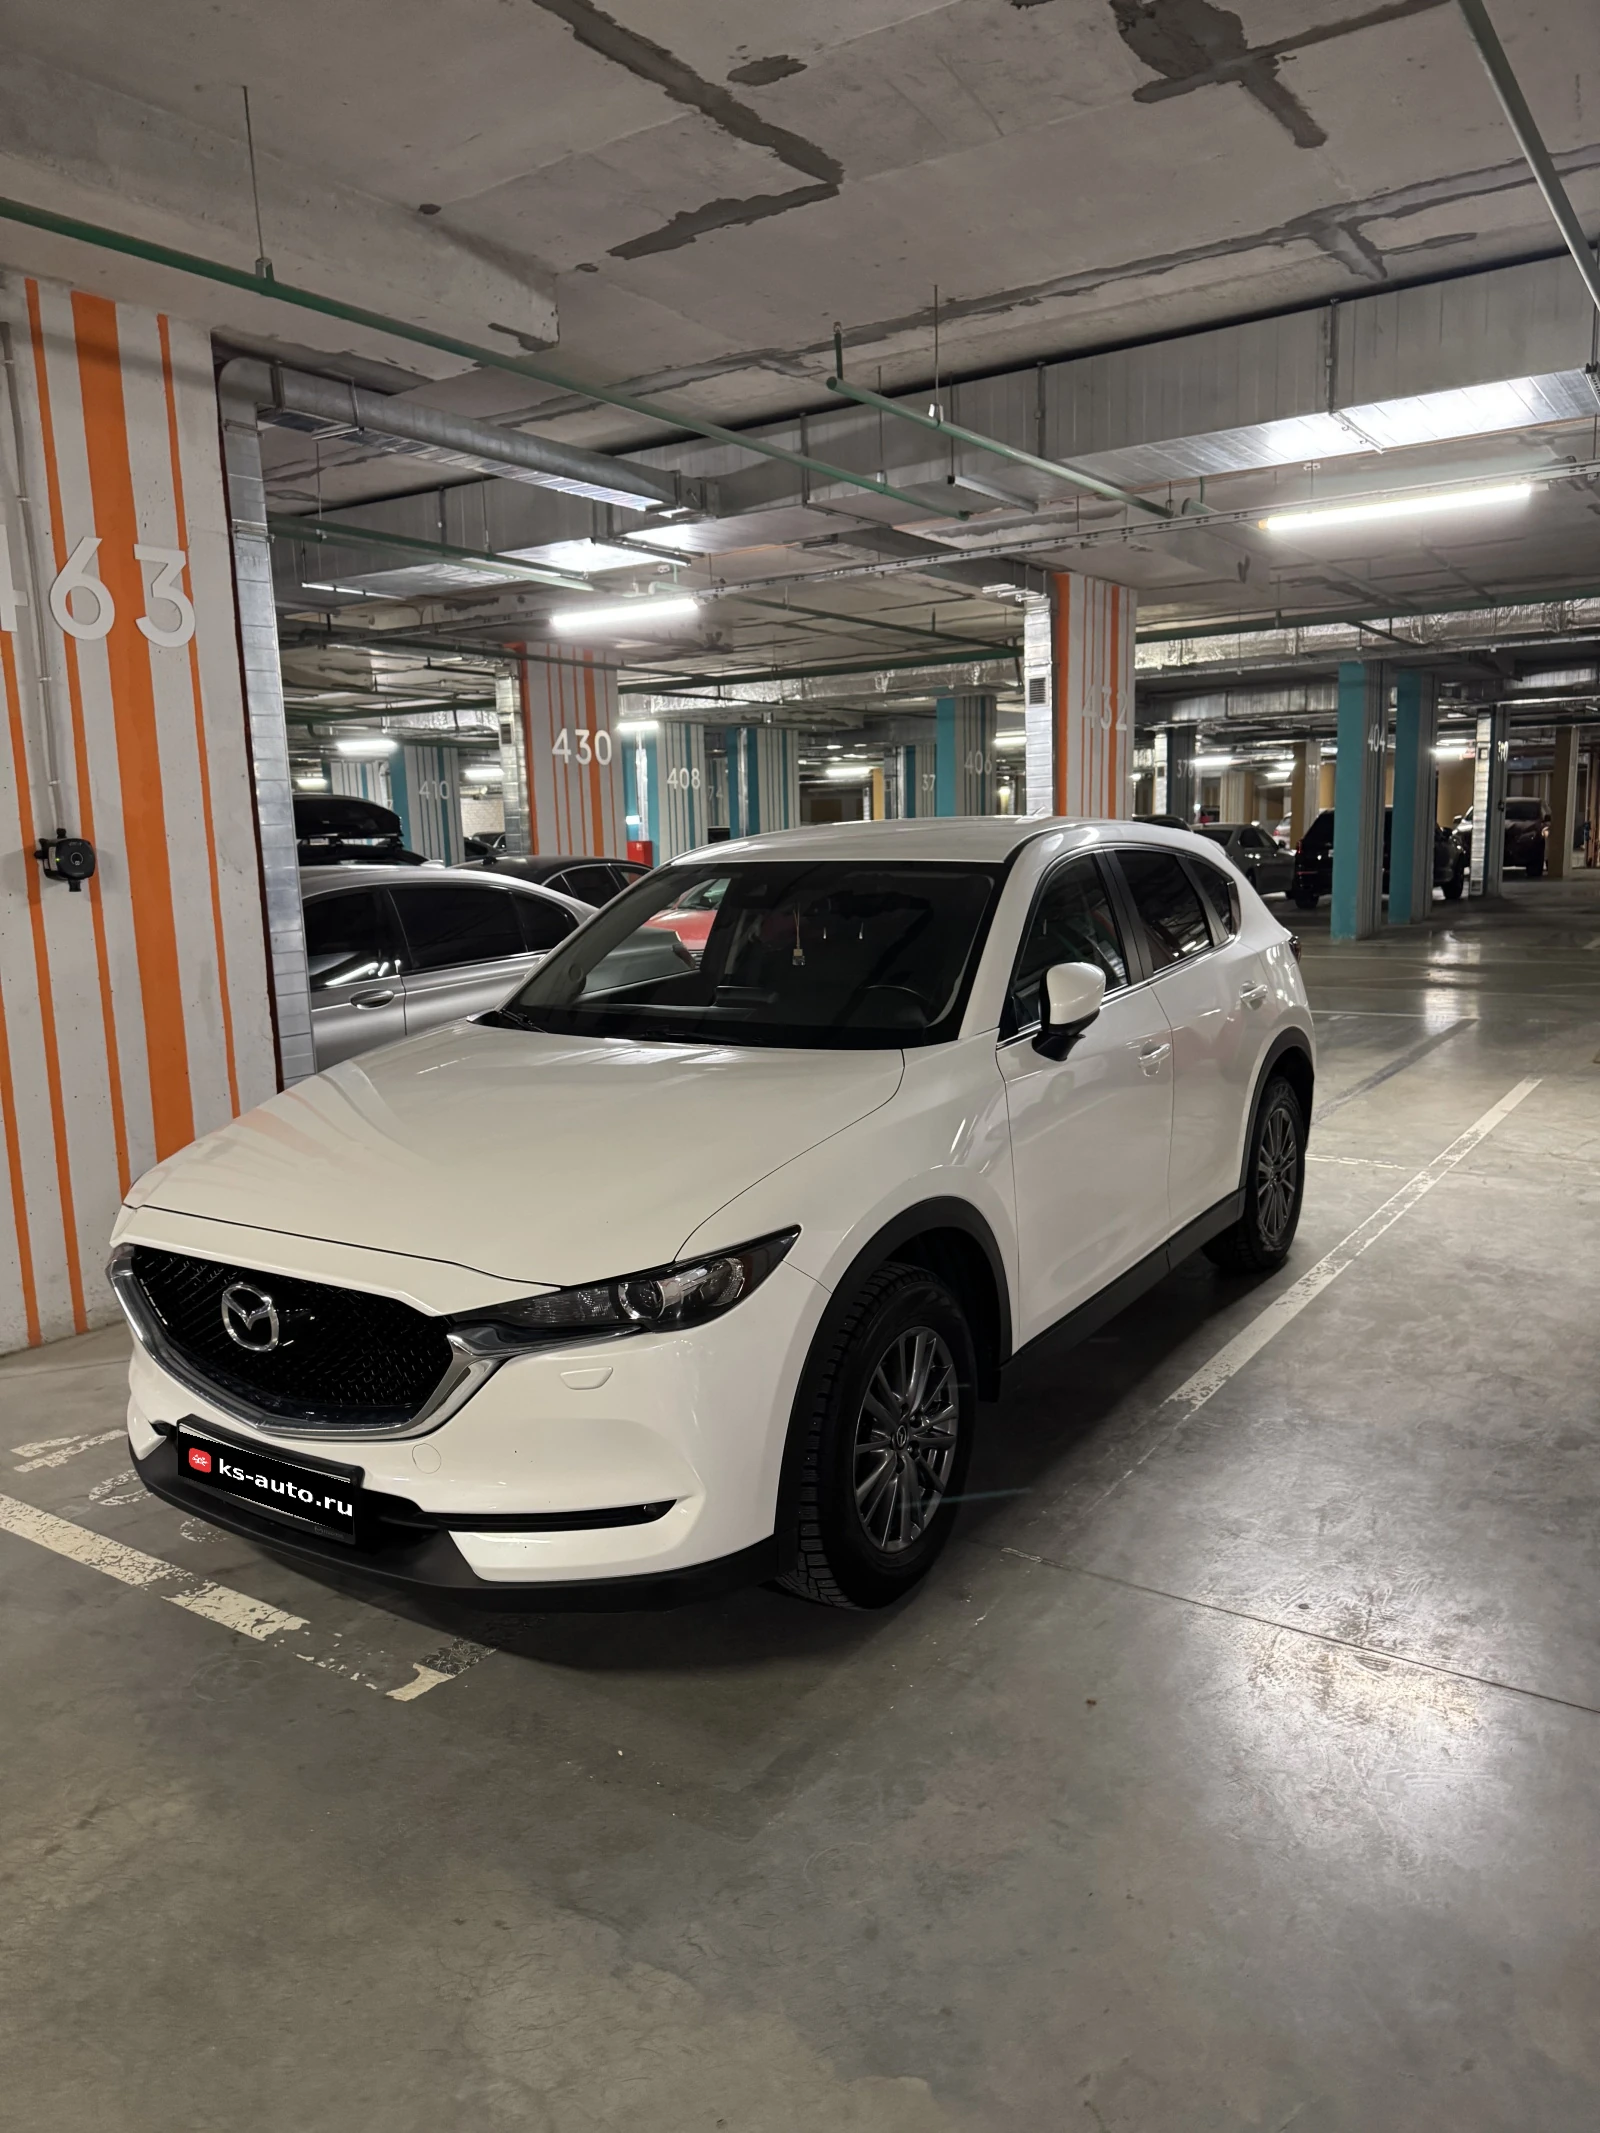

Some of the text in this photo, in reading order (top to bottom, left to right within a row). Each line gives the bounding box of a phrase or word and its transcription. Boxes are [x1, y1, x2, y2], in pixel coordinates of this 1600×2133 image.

[1082, 684, 1128, 731] 432
[552, 727, 612, 766] 430
[1367, 723, 1386, 753] 404
[964, 750, 992, 775] 406
[418, 779, 450, 800] 410
[667, 767, 701, 790] 408
